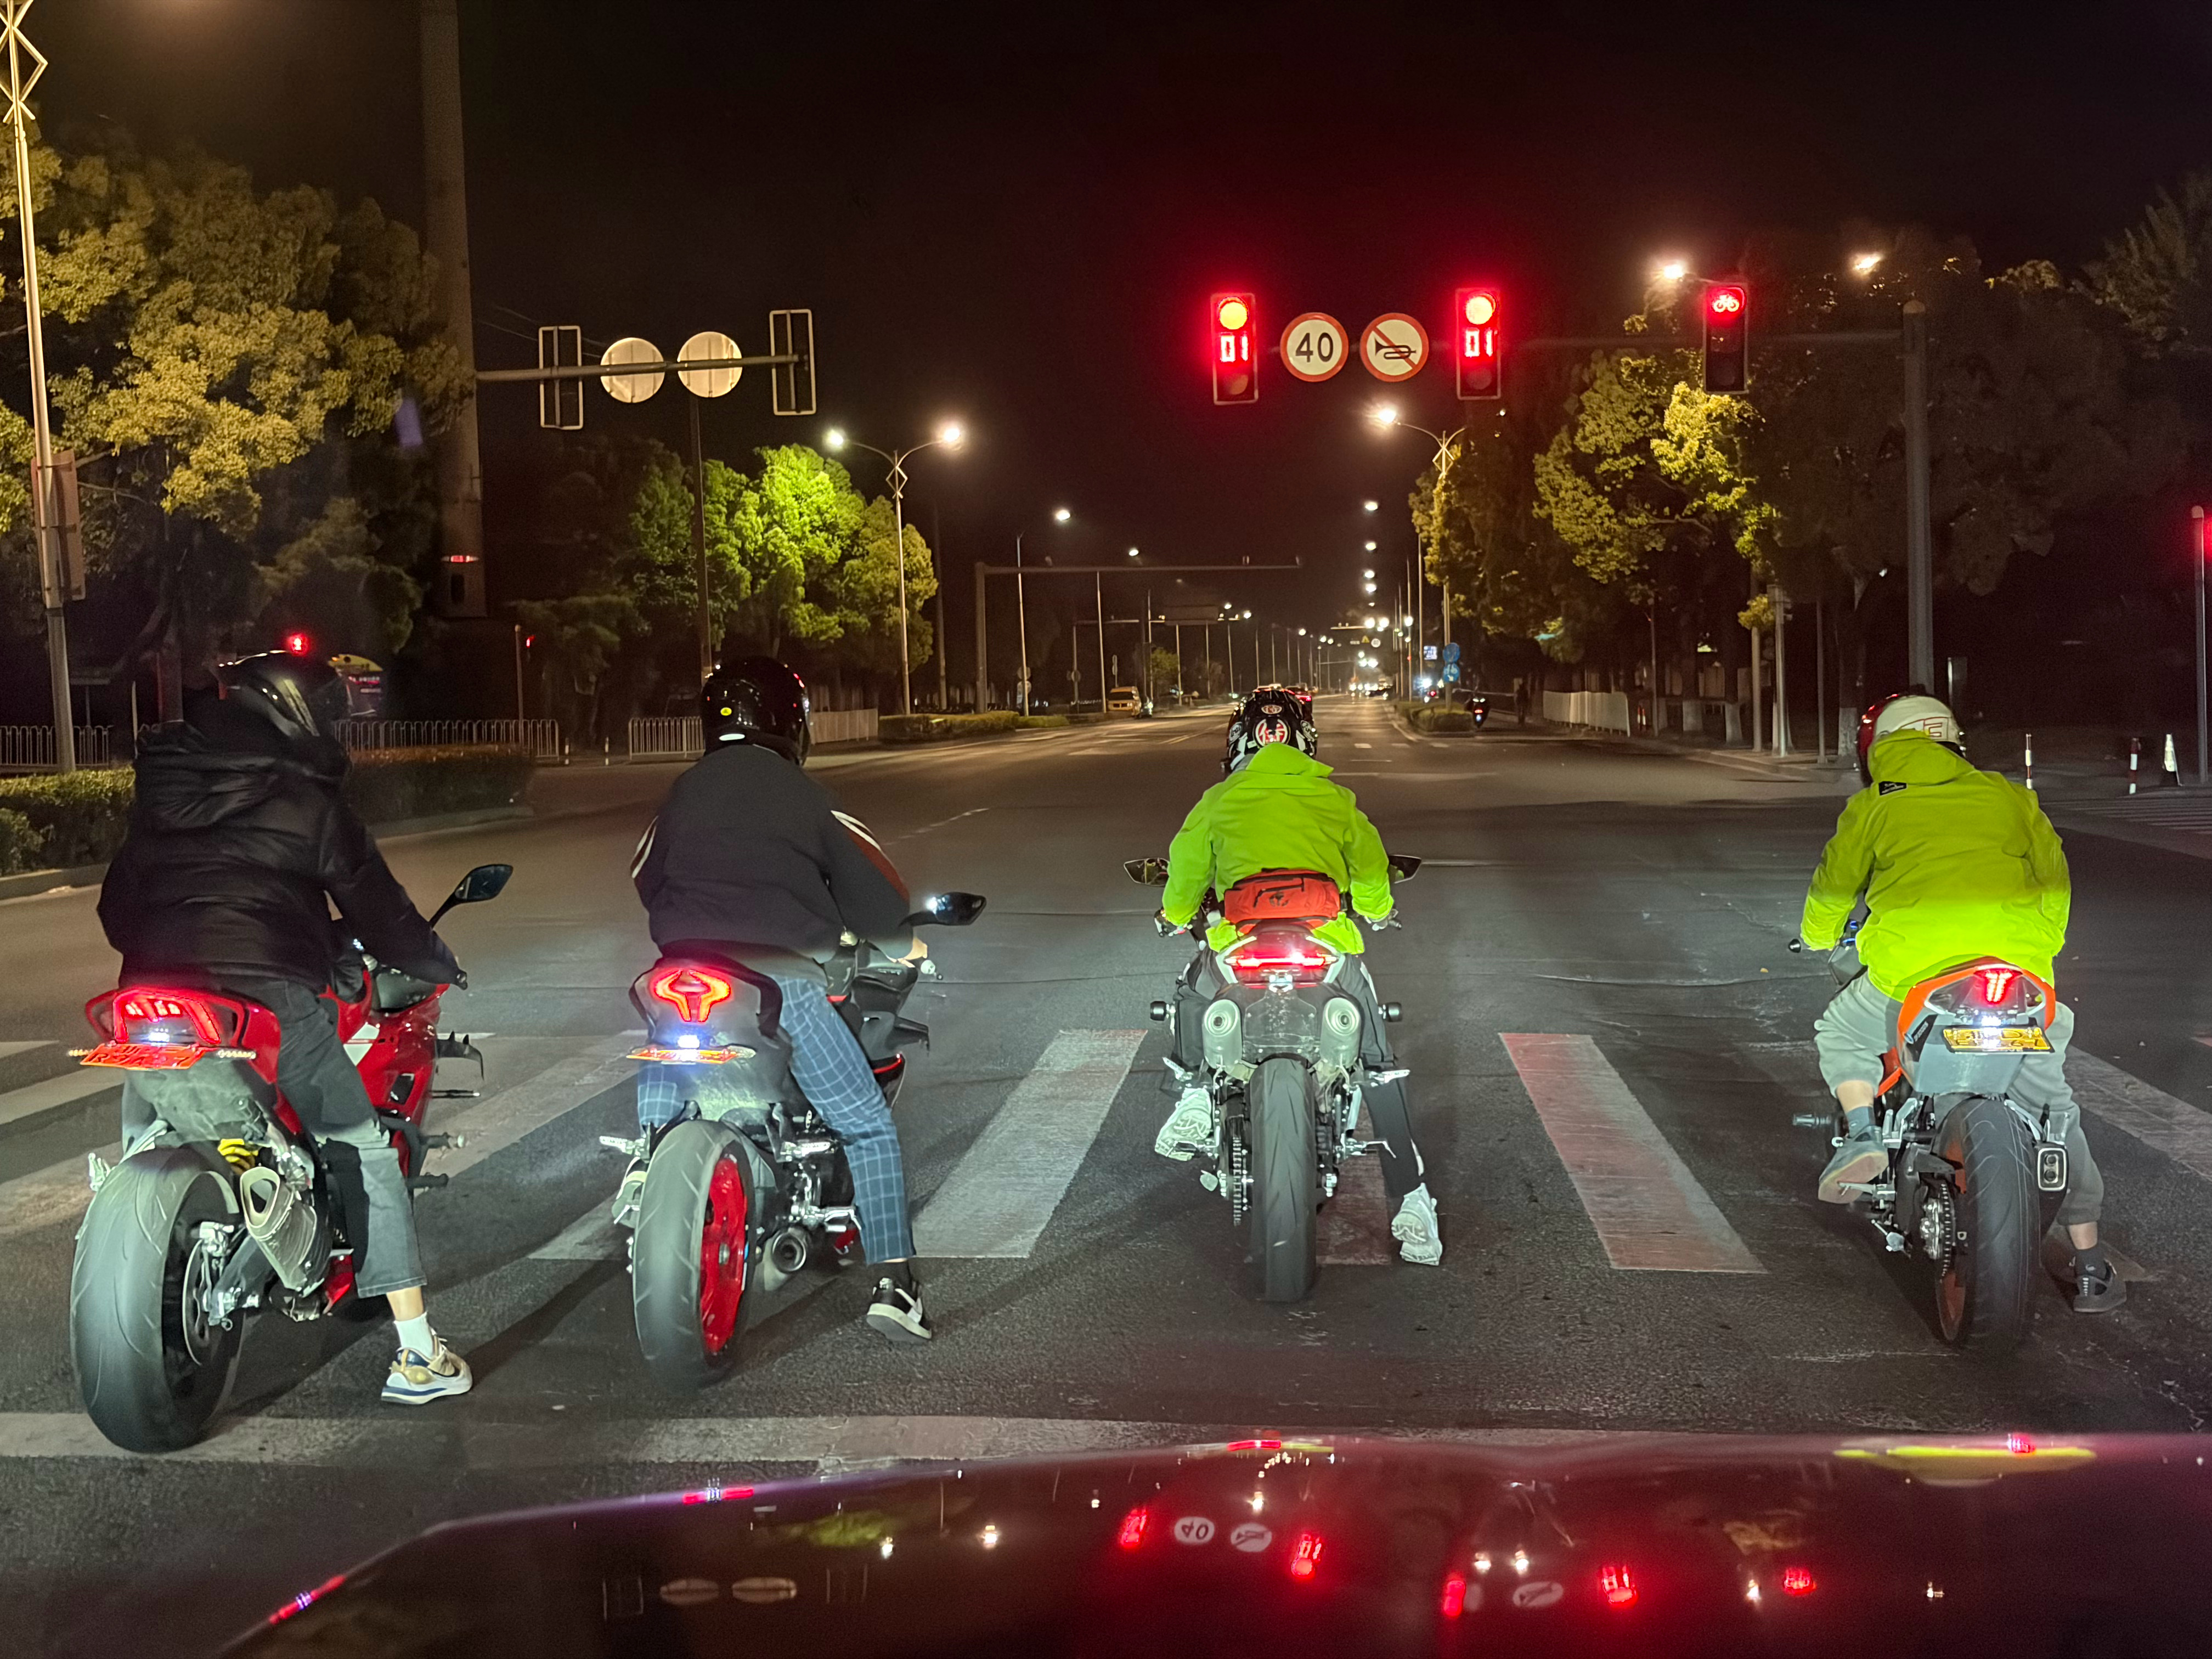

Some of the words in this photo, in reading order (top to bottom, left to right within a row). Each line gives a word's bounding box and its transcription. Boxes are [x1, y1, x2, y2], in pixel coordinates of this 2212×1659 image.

[1220, 332, 1249, 362] 01
[1295, 332, 1334, 363] 40
[1465, 328, 1493, 357] 01
